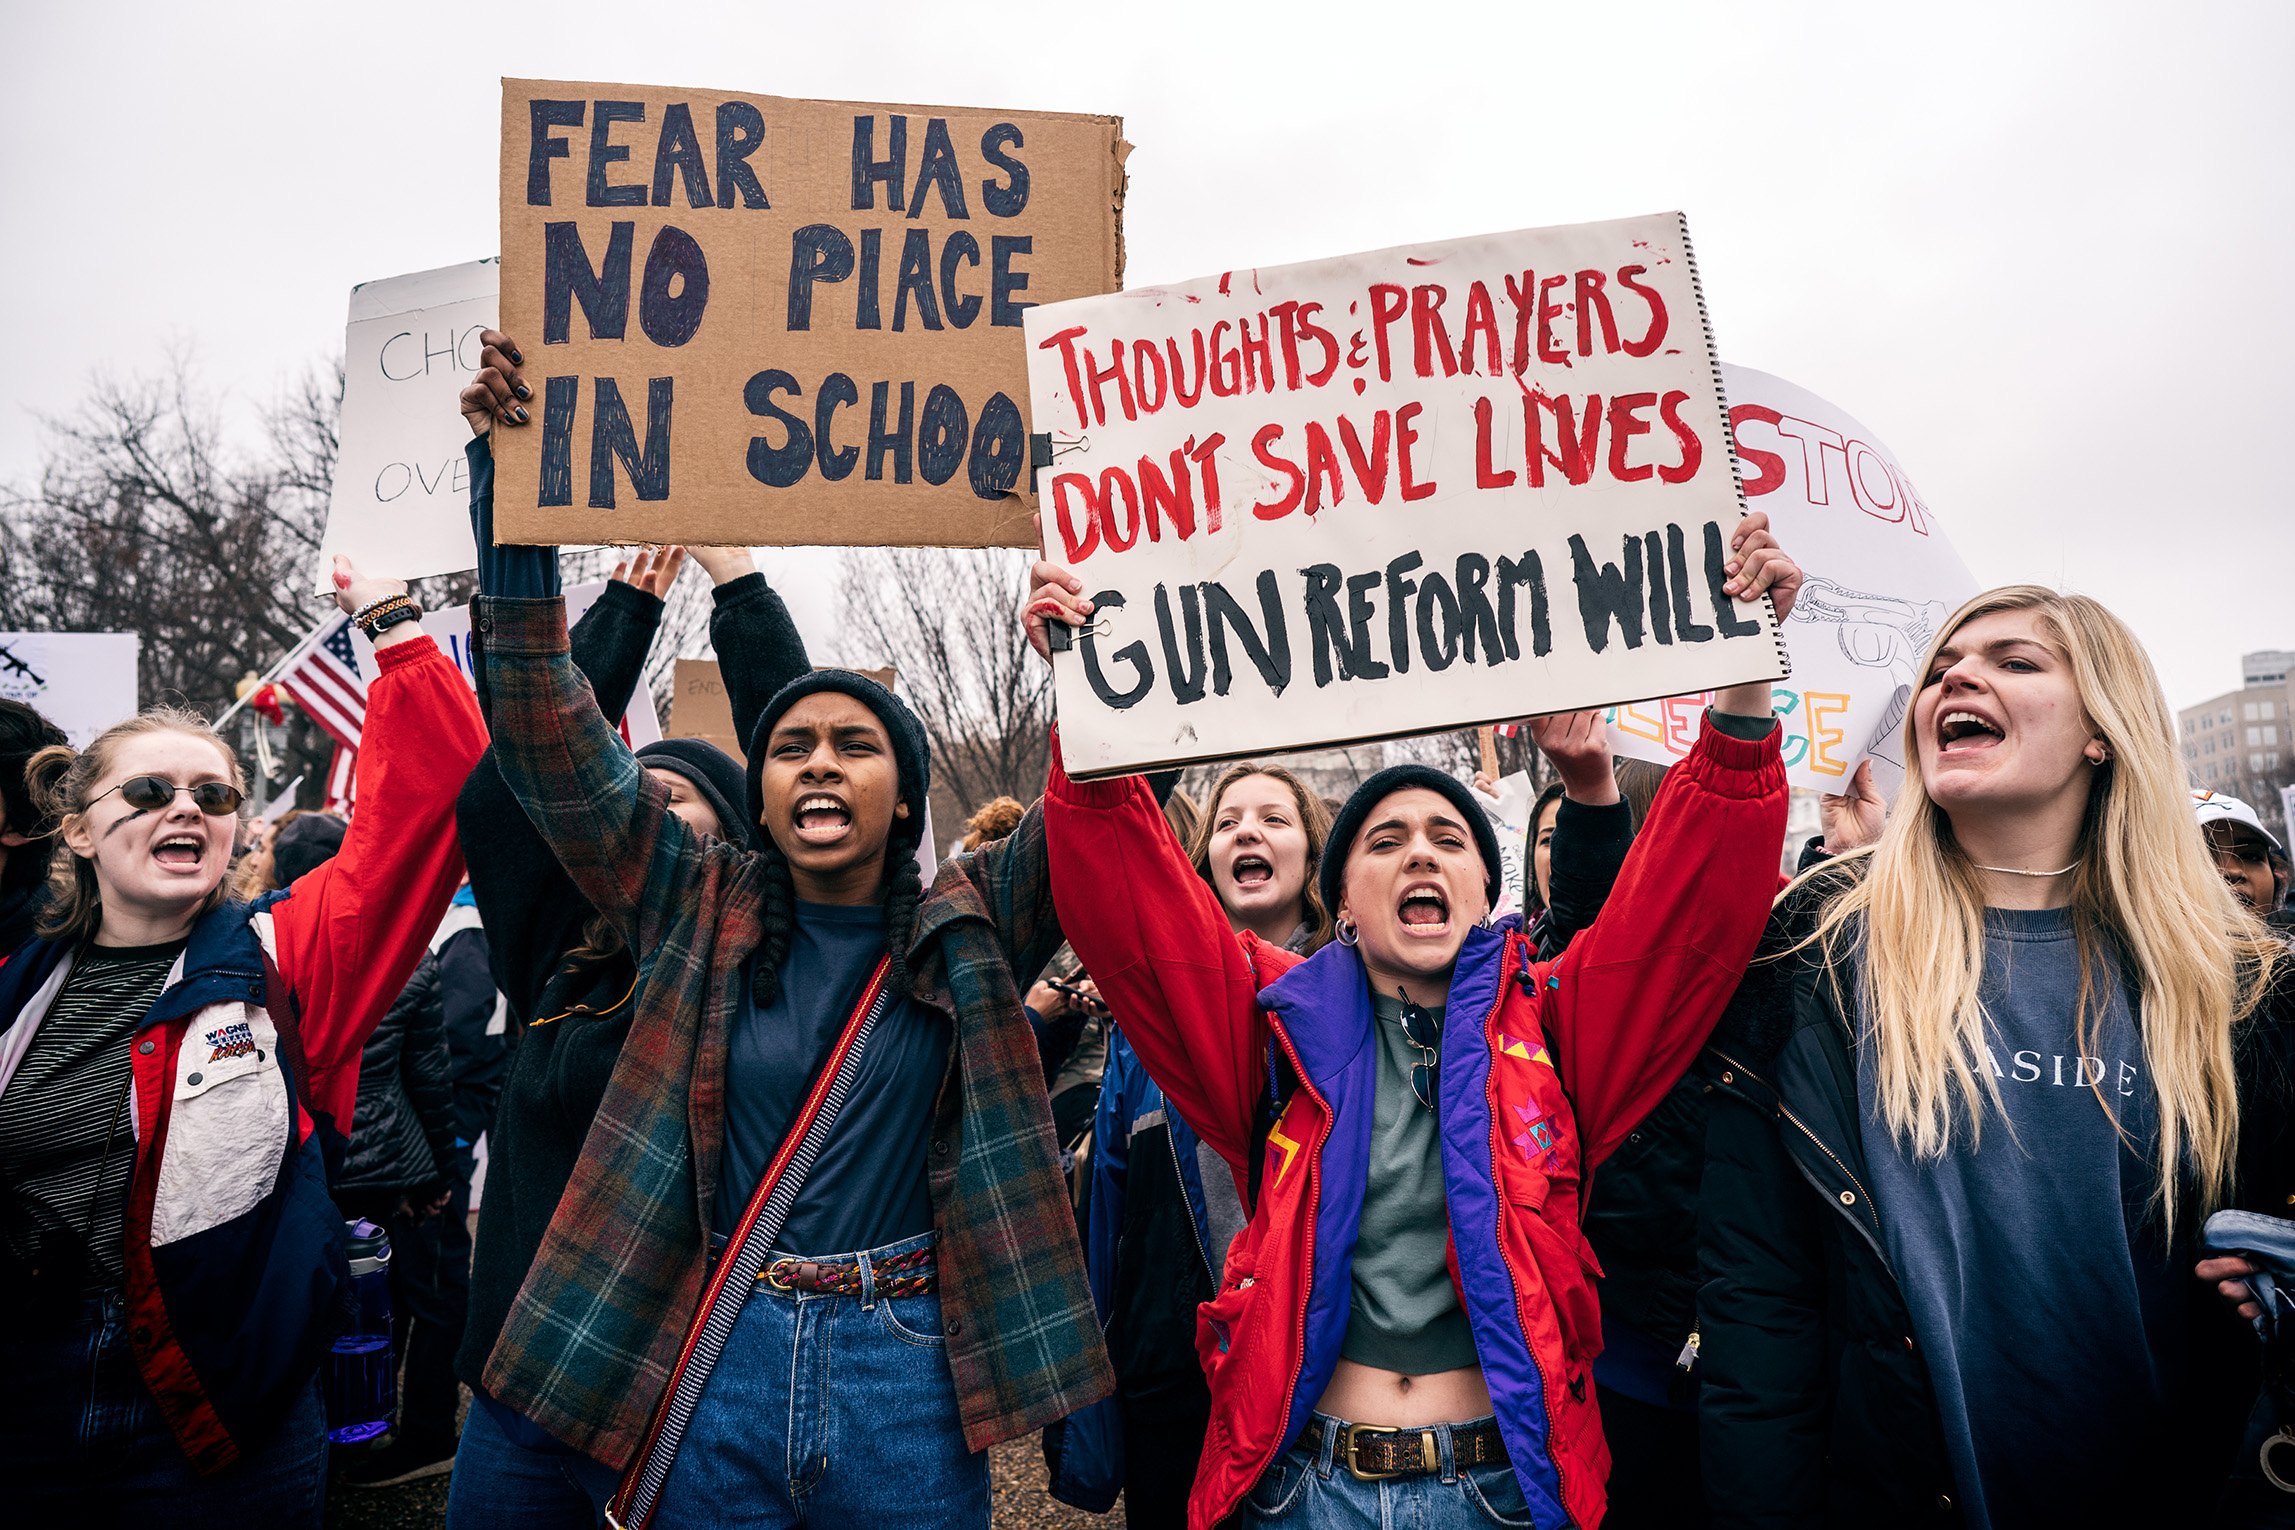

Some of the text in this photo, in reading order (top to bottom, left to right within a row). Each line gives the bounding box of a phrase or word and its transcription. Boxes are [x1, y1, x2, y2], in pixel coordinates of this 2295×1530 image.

[527, 100, 1030, 219] FEAR HAS
[544, 221, 710, 347] NO
[380, 324, 489, 382] CHO
[1039, 301, 1340, 429] THOUGHTS
[1368, 266, 1669, 382] PRAYERS
[375, 456, 469, 502] OVE
[538, 369, 1038, 511] IN SCHOO
[1052, 390, 1703, 564] DON'T SAVE LIVES
[1080, 521, 1761, 712] GUN REFORM WILL
[688, 678, 725, 695] END
[1949, 1045, 2137, 1096] ASIDE
